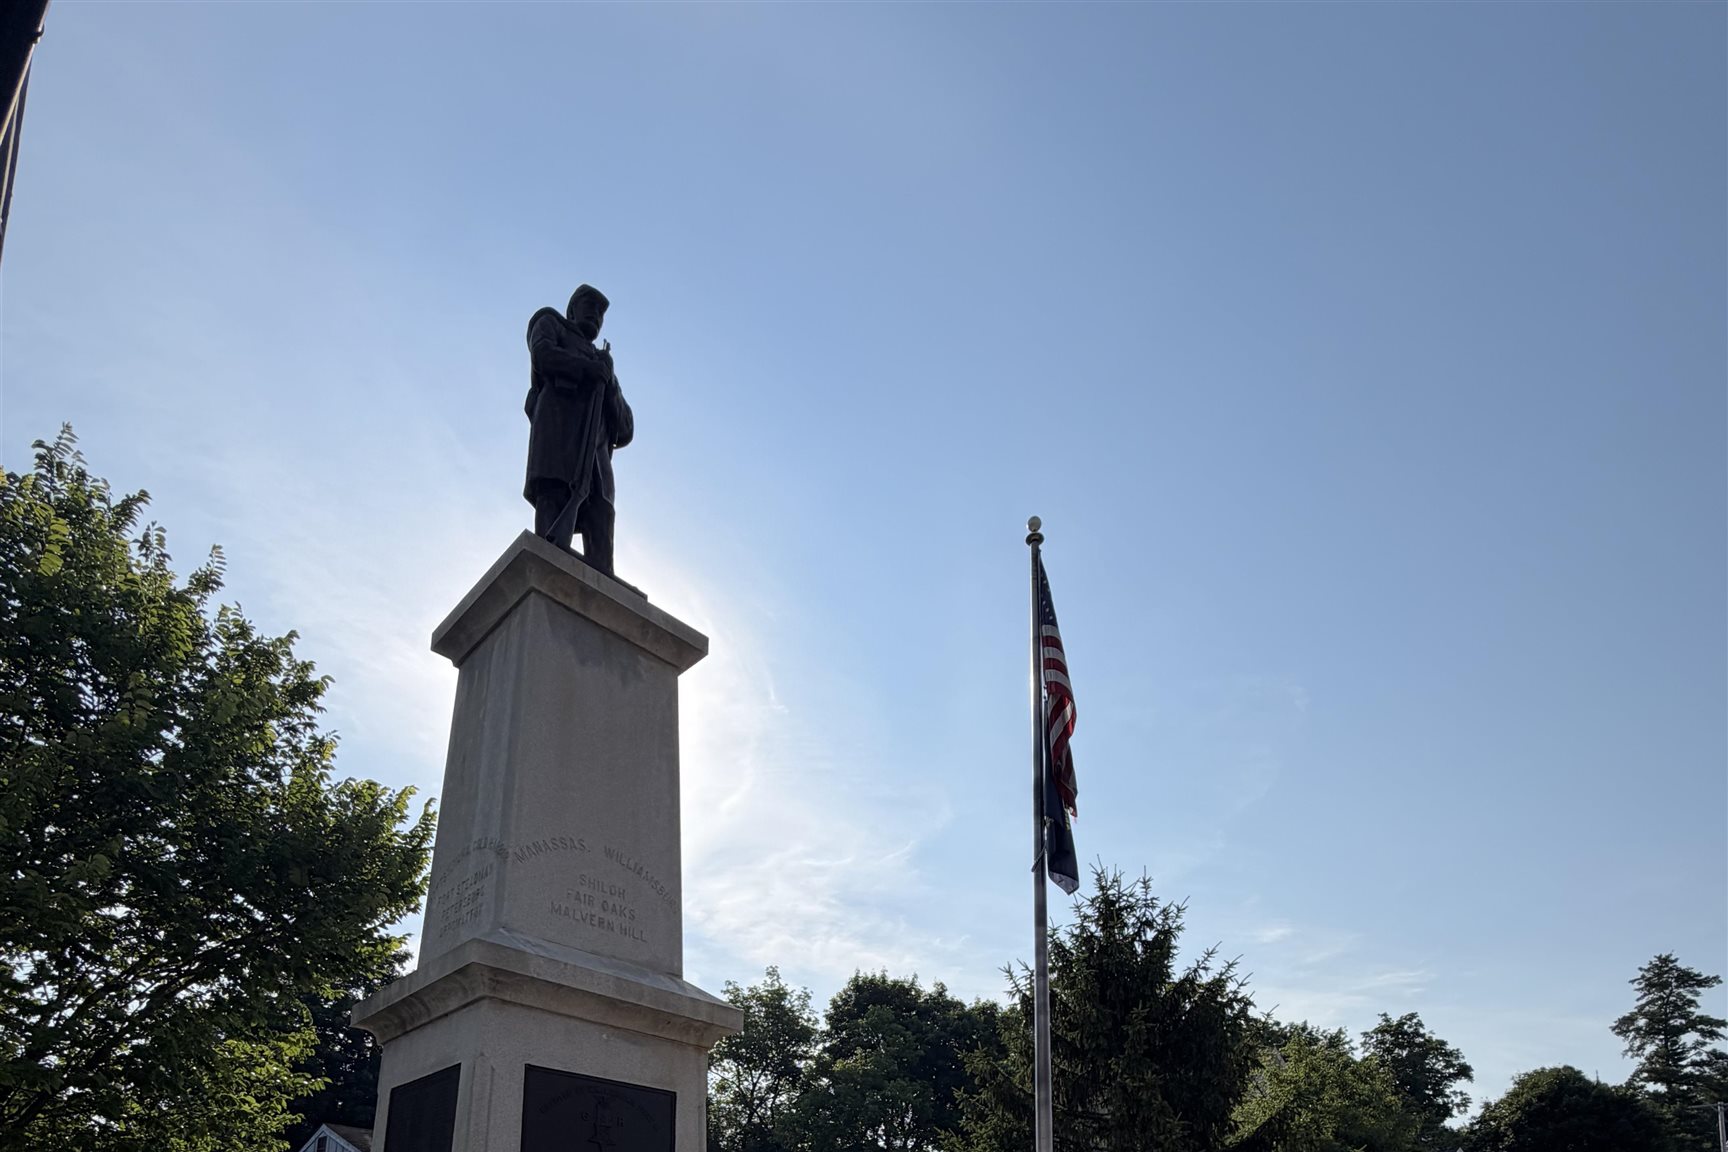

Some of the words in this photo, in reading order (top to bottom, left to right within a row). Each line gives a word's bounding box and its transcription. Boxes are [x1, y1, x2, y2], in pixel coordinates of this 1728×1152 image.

[579, 873, 626, 900] SHILOH
[550, 900, 615, 933] MALVERN
[619, 922, 648, 943] HILL
[566, 887, 595, 908] FAIR
[600, 899, 637, 922] OAKS
